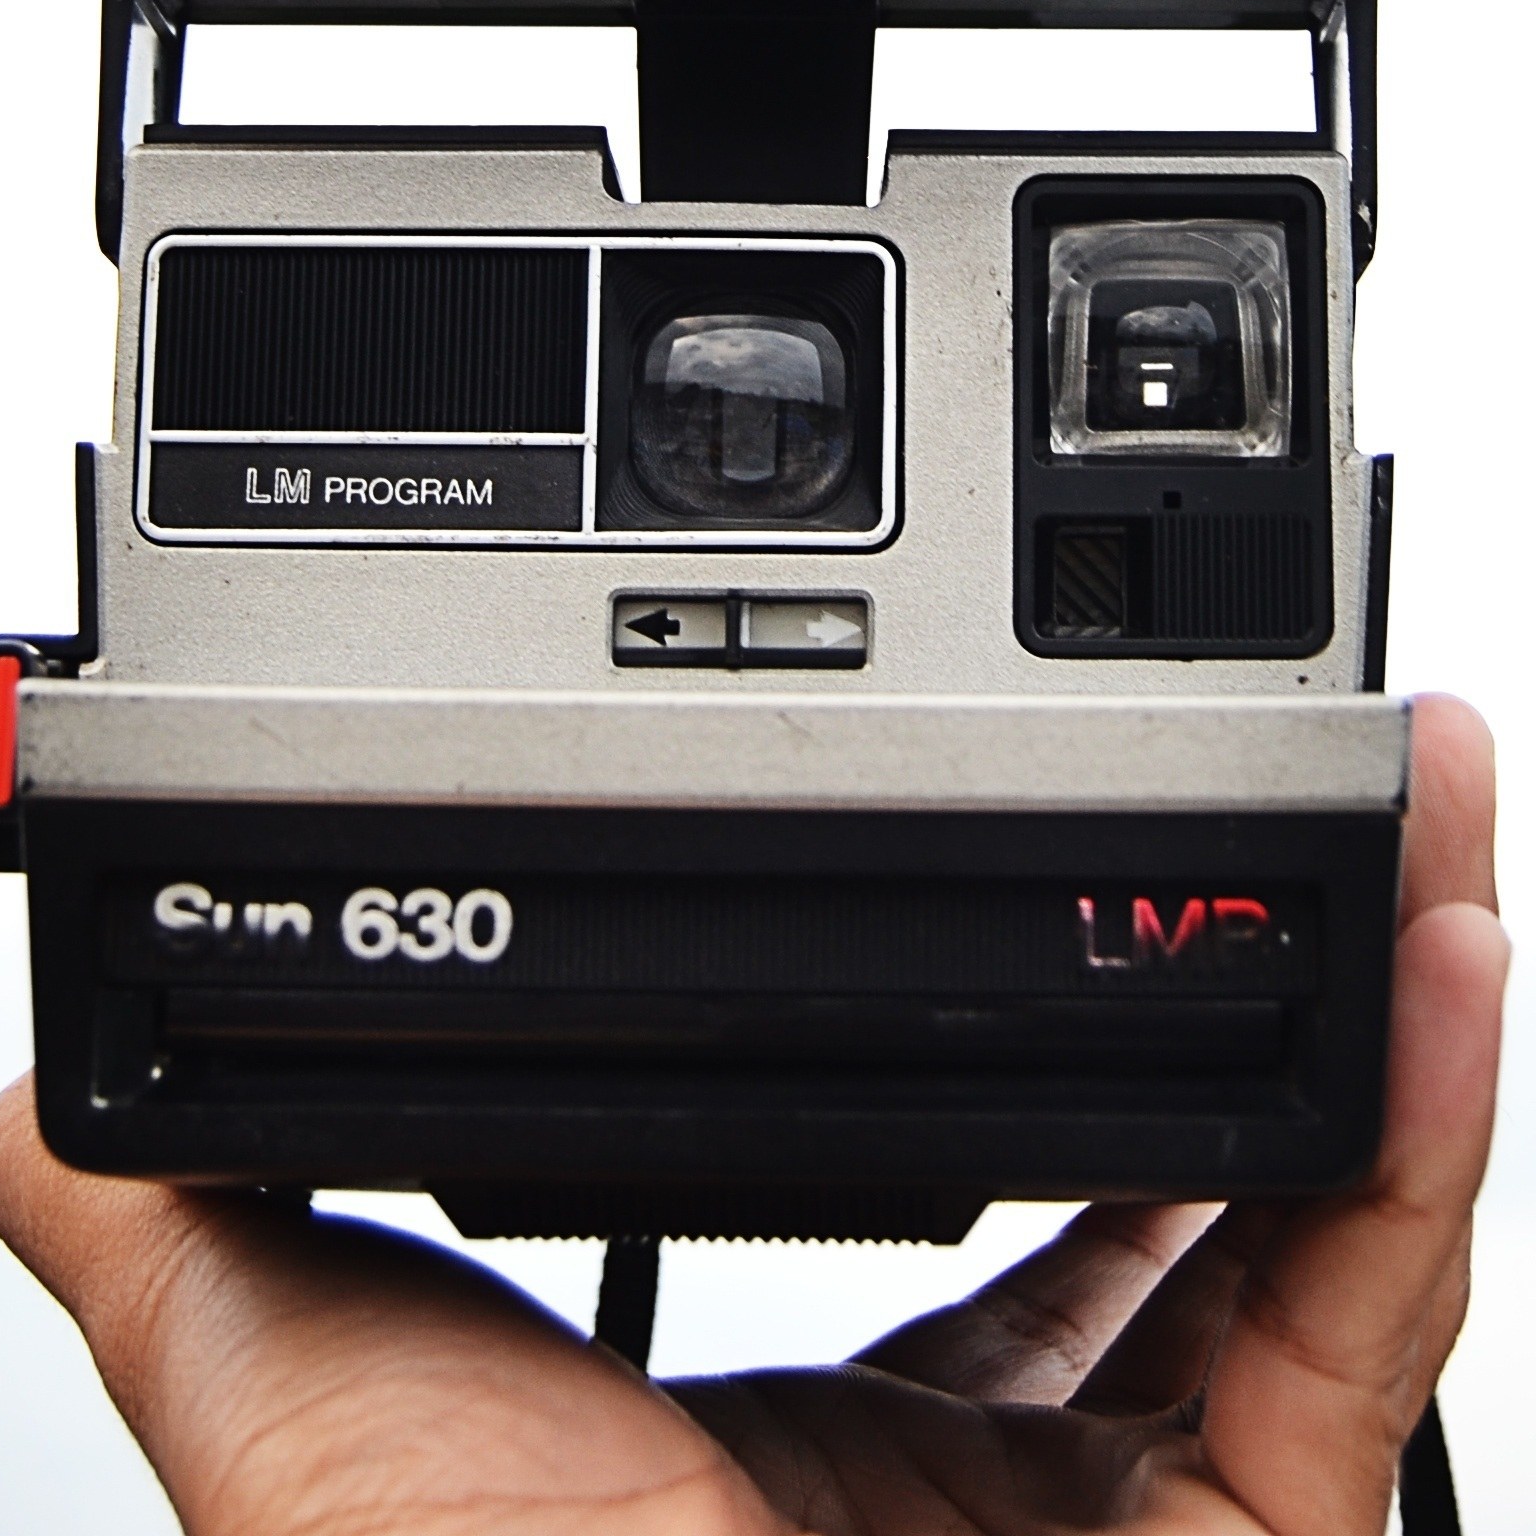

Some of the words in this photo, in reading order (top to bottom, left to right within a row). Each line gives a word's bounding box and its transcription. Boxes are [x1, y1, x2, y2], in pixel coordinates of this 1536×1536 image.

[245, 467, 311, 505] LM
[324, 476, 493, 506] PROGRAM
[340, 886, 514, 963] 630
